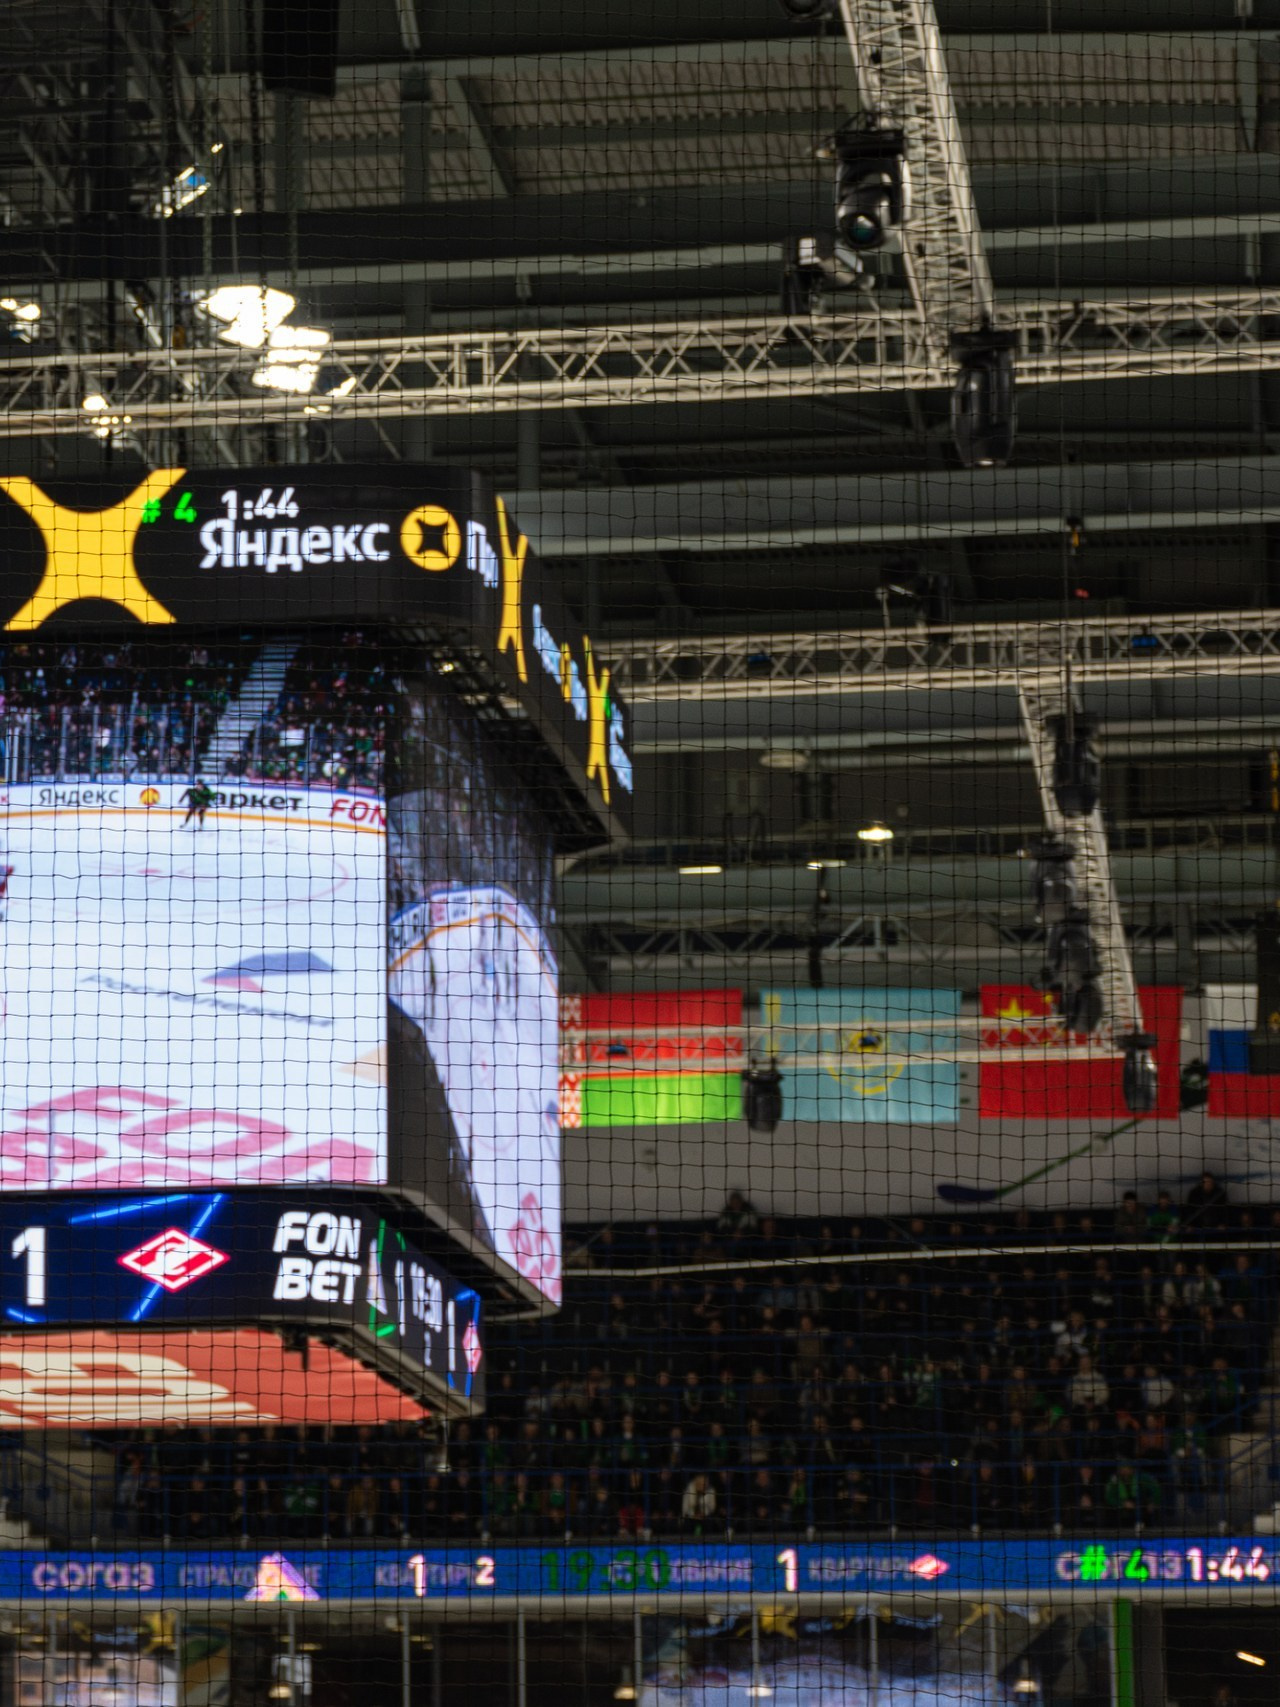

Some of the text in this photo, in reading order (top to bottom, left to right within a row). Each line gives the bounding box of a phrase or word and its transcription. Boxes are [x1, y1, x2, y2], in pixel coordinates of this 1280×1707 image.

[173, 492, 197, 523] 4
[220, 487, 300, 521] 1:44
[199, 518, 391, 573] Яндекс
[38, 787, 303, 812] Яндекс аркет
[272, 1211, 363, 1260] FON
[11, 1225, 48, 1307] 1
[273, 1257, 362, 1305] BET
[407, 1553, 427, 1598] 1
[475, 1556, 496, 1586] 2
[541, 1548, 671, 1592] 19:30
[777, 1548, 798, 1592] 1
[1186, 1546, 1270, 1582] 1:44
